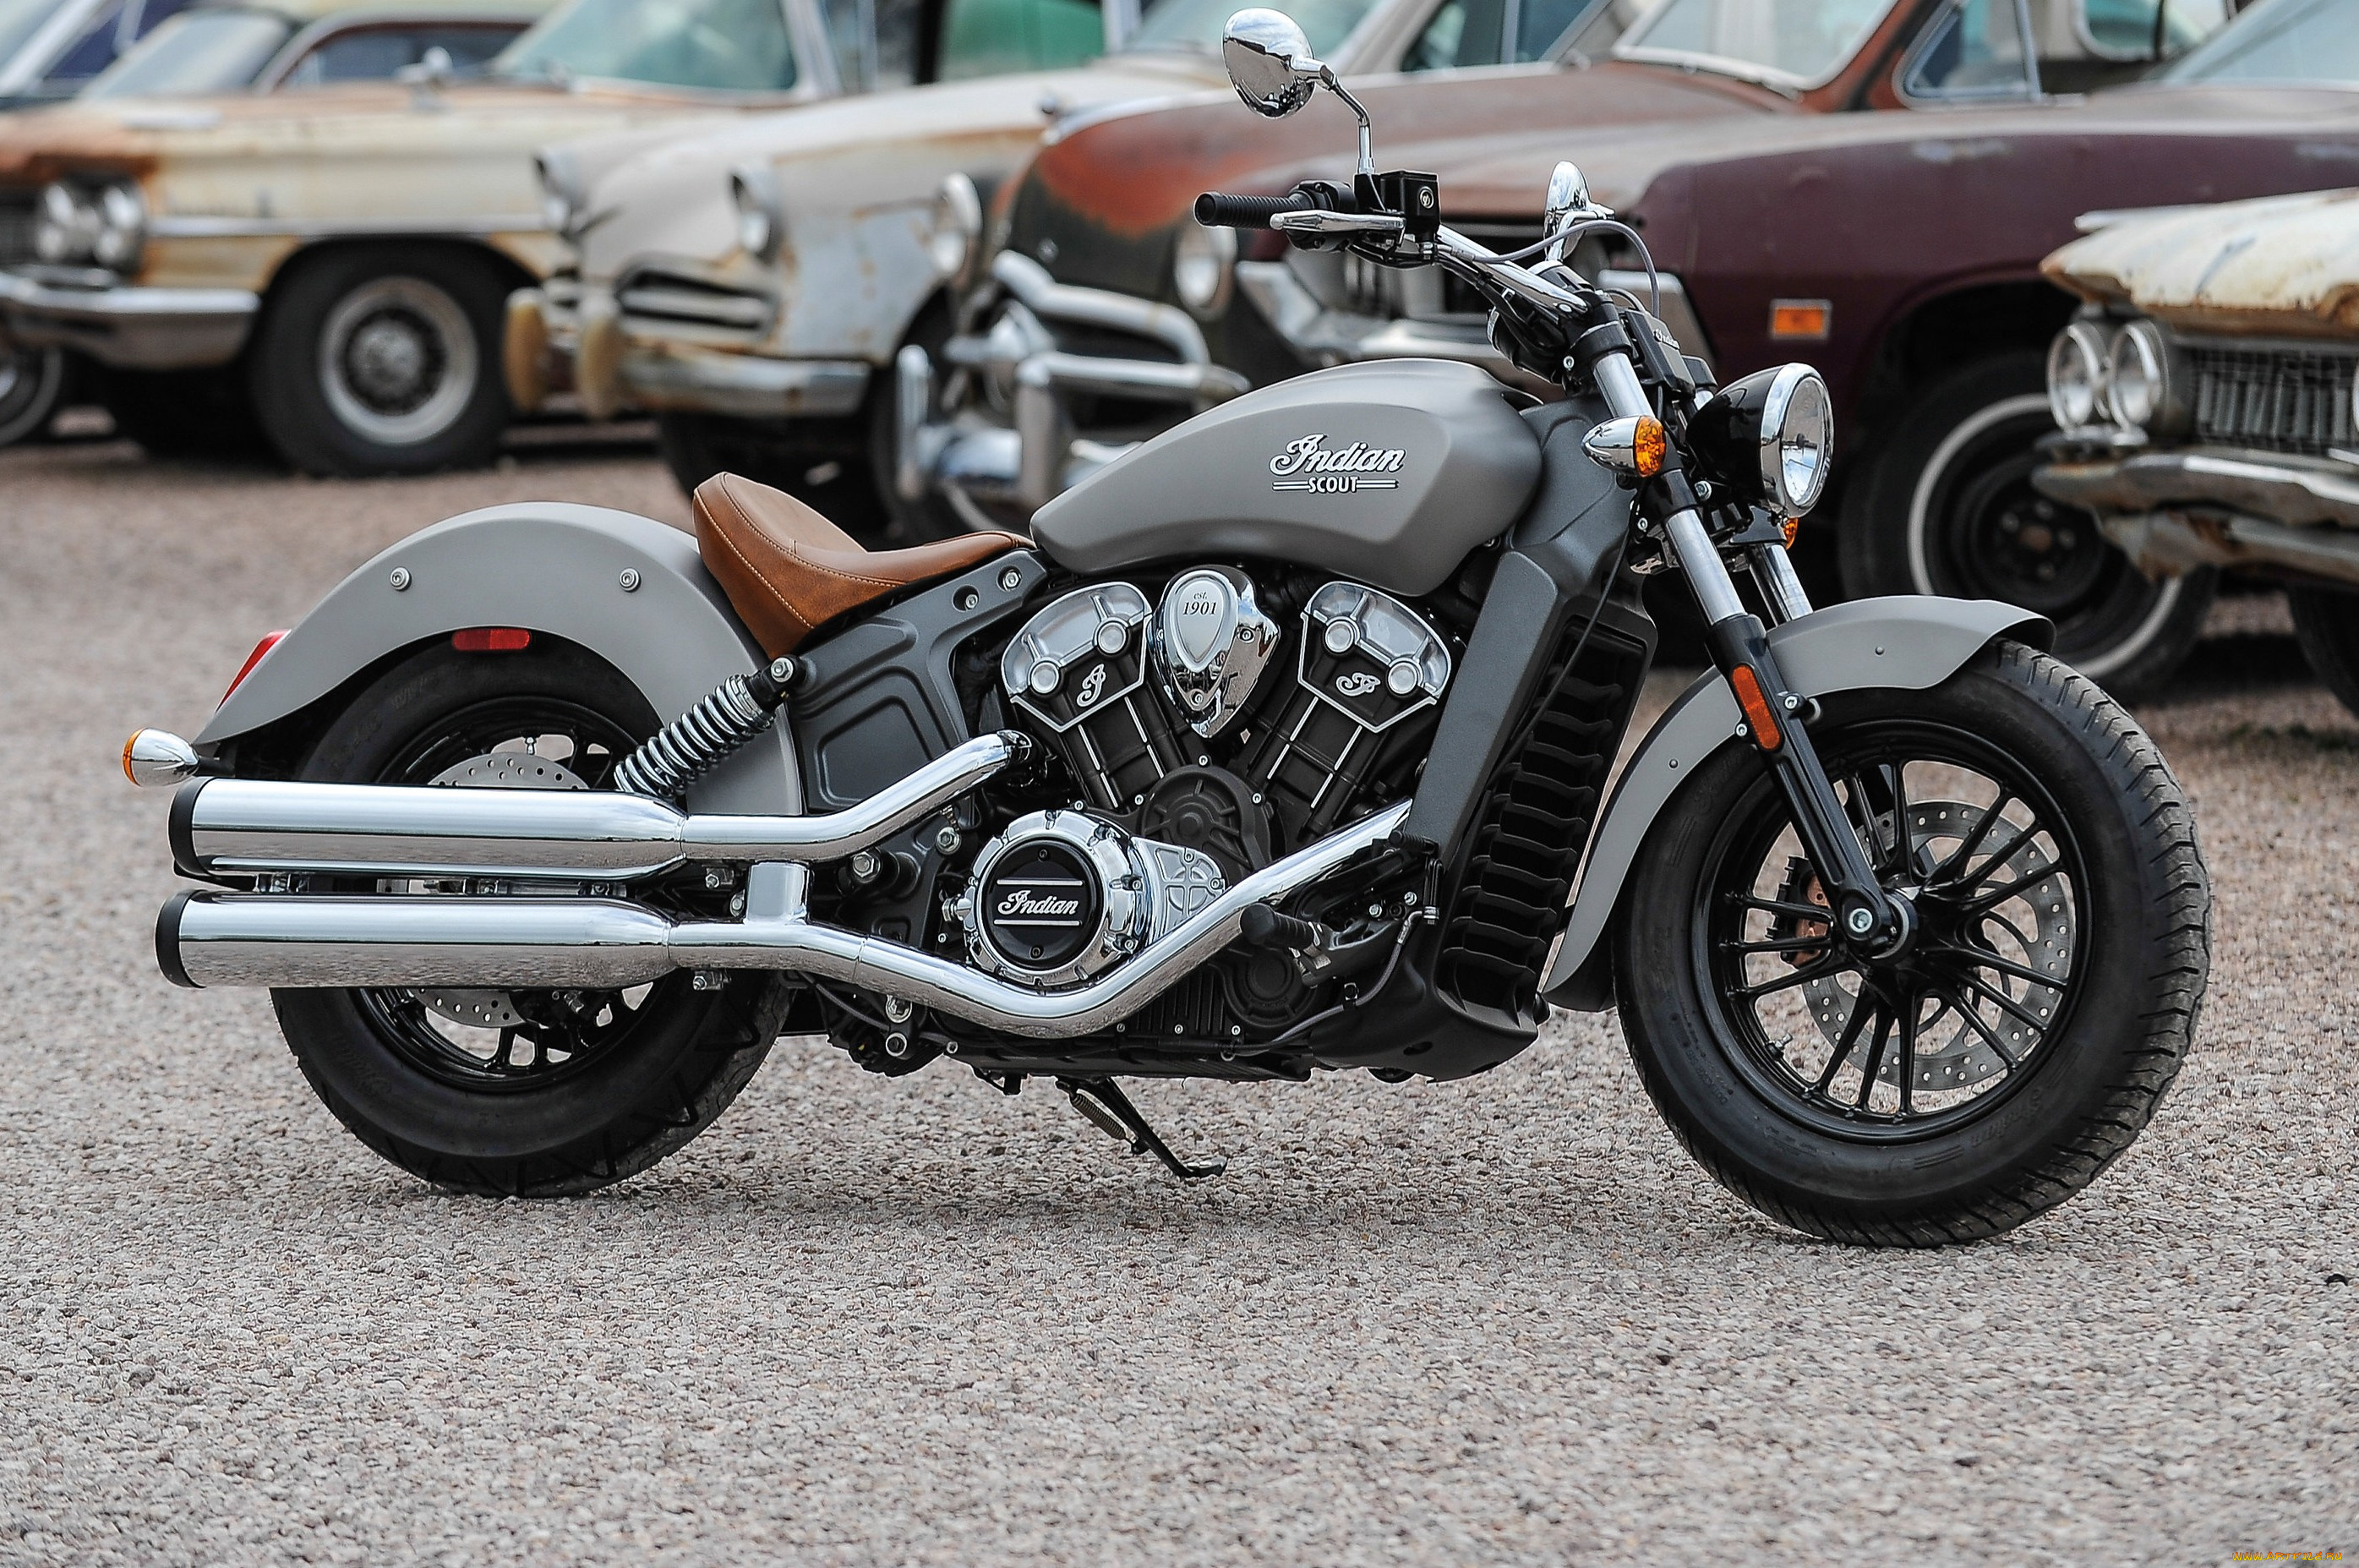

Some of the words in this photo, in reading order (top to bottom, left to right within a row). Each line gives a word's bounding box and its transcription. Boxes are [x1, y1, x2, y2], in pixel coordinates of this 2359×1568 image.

[1269, 434, 1406, 476] Indian
[1308, 476, 1360, 494] SCOUT
[1182, 601, 1217, 615] 1901
[997, 889, 1078, 915] Indian
